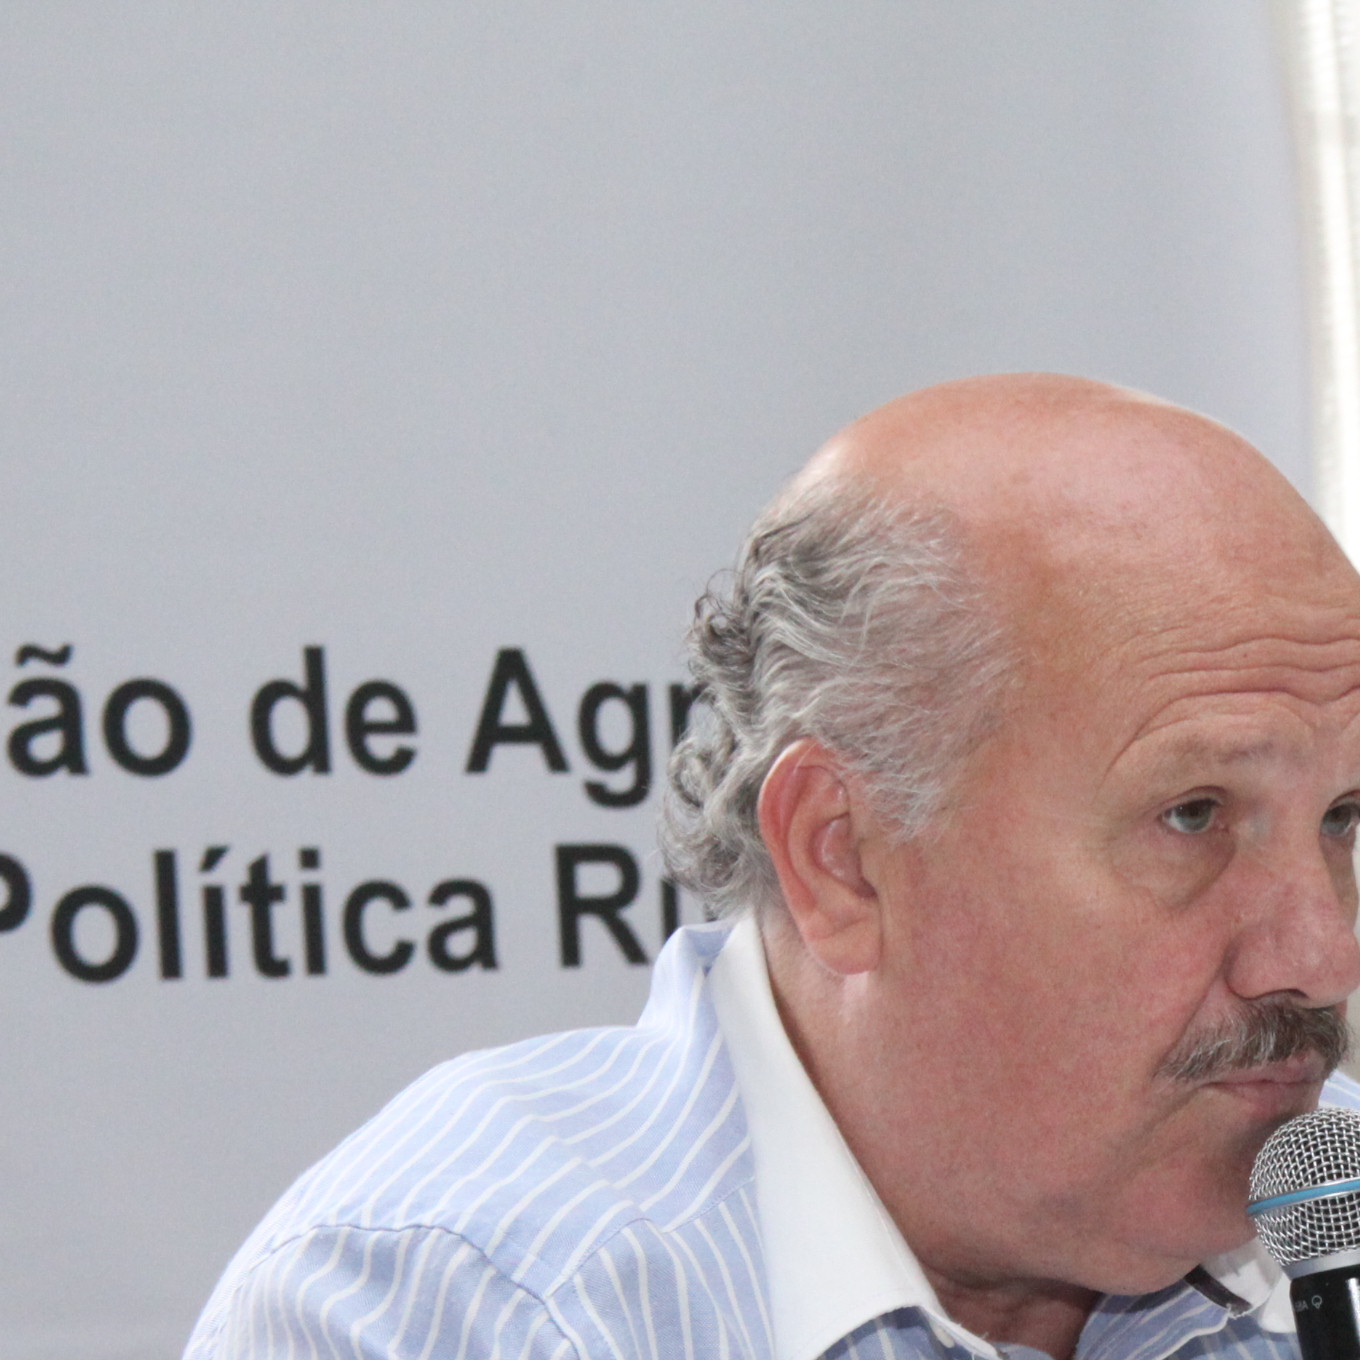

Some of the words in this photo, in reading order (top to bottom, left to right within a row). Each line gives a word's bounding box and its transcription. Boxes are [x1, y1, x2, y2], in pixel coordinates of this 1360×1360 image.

[6, 642, 192, 779] ão
[250, 644, 418, 778] de
[554, 845, 680, 969] R
